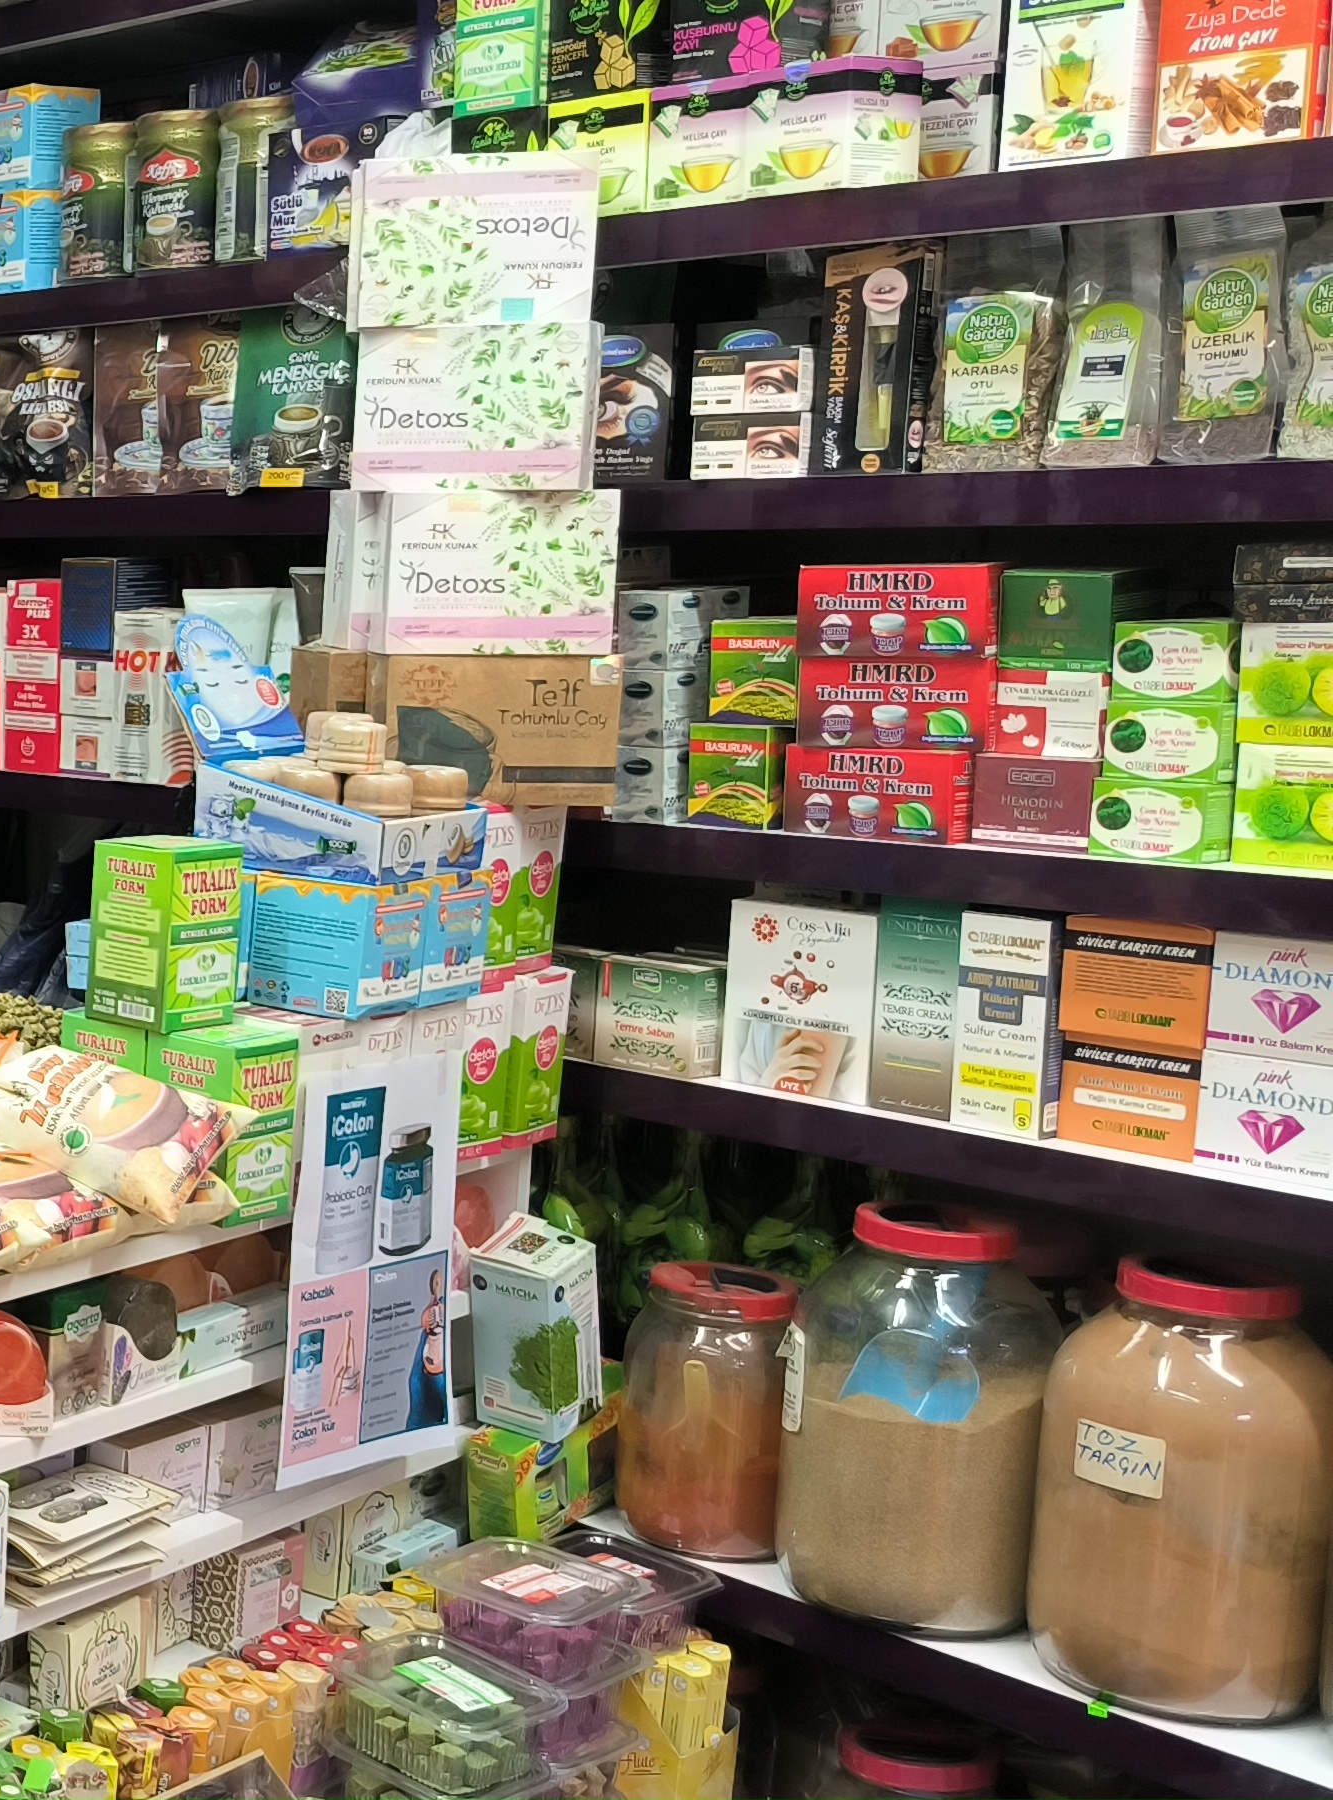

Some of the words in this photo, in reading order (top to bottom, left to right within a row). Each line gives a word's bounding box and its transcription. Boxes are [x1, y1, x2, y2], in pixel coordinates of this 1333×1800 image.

[1184, 8, 1229, 36] Ziya
[1233, 1, 1287, 24] Dede
[673, 21, 738, 42] KUŞBURNU
[1188, 29, 1236, 54] ATOM
[1237, 27, 1279, 51] ÇAYI
[141, 188, 190, 209] Menengiç
[142, 197, 187, 219] Kahvesi
[476, 216, 570, 239] Detoxs
[1207, 278, 1248, 296] Natur
[1201, 291, 1253, 311] Garden
[970, 313, 1011, 329] Natur
[963, 325, 1015, 342] Garden
[1190, 331, 1256, 350] ÜZERLİK
[1197, 347, 1249, 362] TOHUMU
[366, 374, 407, 386] FERİDUN
[408, 376, 442, 385] KUNAK
[951, 363, 1019, 379] KARABAŞ
[378, 407, 469, 429] Detoxs
[401, 541, 442, 552] FERİDUN
[444, 542, 479, 551] KUNAK
[414, 569, 506, 594] Detoxs
[847, 572, 934, 593] HMRD
[814, 595, 883, 611] Tohum
[887, 595, 907, 610] &
[910, 595, 967, 611] Krem
[728, 638, 781, 650] BASURUN
[114, 650, 161, 674] HOT
[849, 663, 937, 685] HMRD
[526, 678, 585, 708] Teff
[816, 686, 884, 702] Tohum
[889, 687, 908, 702] &
[912, 686, 969, 703] Krem
[497, 709, 571, 727] Tohumlu
[573, 709, 609, 730] Çay
[704, 741, 753, 754] BASURUN
[827, 751, 904, 777] HMRD
[799, 773, 860, 793] Tohum
[862, 777, 880, 793] &
[882, 779, 933, 797] Krem
[227, 779, 254, 796] Mentol
[300, 803, 327, 821] Keyfini
[329, 811, 353, 828] Sürün
[1000, 794, 1064, 811] HEMODİN
[1013, 808, 1048, 822] KREM
[107, 857, 157, 879] TURALIX
[114, 877, 146, 894] FORM
[182, 867, 237, 895] TURALIX
[190, 896, 228, 916] FORM
[886, 920, 959, 938] ENDERMA
[1076, 934, 1118, 950] SİVİLCE
[1119, 939, 1165, 956] KARŞITI
[1166, 944, 1197, 959] KREM
[1267, 948, 1308, 968] pink
[743, 1009, 784, 1024] KÜKÜRTLÜ
[785, 1017, 801, 1026] CİLT
[803, 1018, 830, 1030] BAKIM
[882, 1003, 915, 1018] TEMRE
[916, 1007, 953, 1022] CREAM
[614, 1019, 644, 1035] Temre
[646, 1023, 675, 1040] Sabun
[963, 1022, 997, 1039] Sulfur
[998, 1029, 1037, 1044] Cream
[75, 1031, 128, 1055] TURALIX
[161, 1050, 217, 1075] TURALIX
[467, 1047, 497, 1064] detox
[1074, 1046, 1115, 1062] SİVİLCE
[1115, 1051, 1157, 1069] KARŞITI
[1158, 1057, 1191, 1074] KREM
[169, 1070, 205, 1088] FORM
[242, 1059, 294, 1090] TURALIX
[967, 1064, 995, 1077] Herbal
[1254, 1069, 1294, 1091] pink
[250, 1090, 284, 1110] FORM
[960, 1096, 981, 1109] Skin
[983, 1101, 1007, 1113] Care
[1211, 1082, 1333, 1117] DIAMOND
[331, 1112, 374, 1138] iColon
[300, 1284, 335, 1303] Kabızlık
[495, 1283, 539, 1302] MATCHA
[66, 1311, 101, 1332] agarta
[1078, 1420, 1144, 1455] TOZ
[1078, 1441, 1163, 1483] TARGIN
